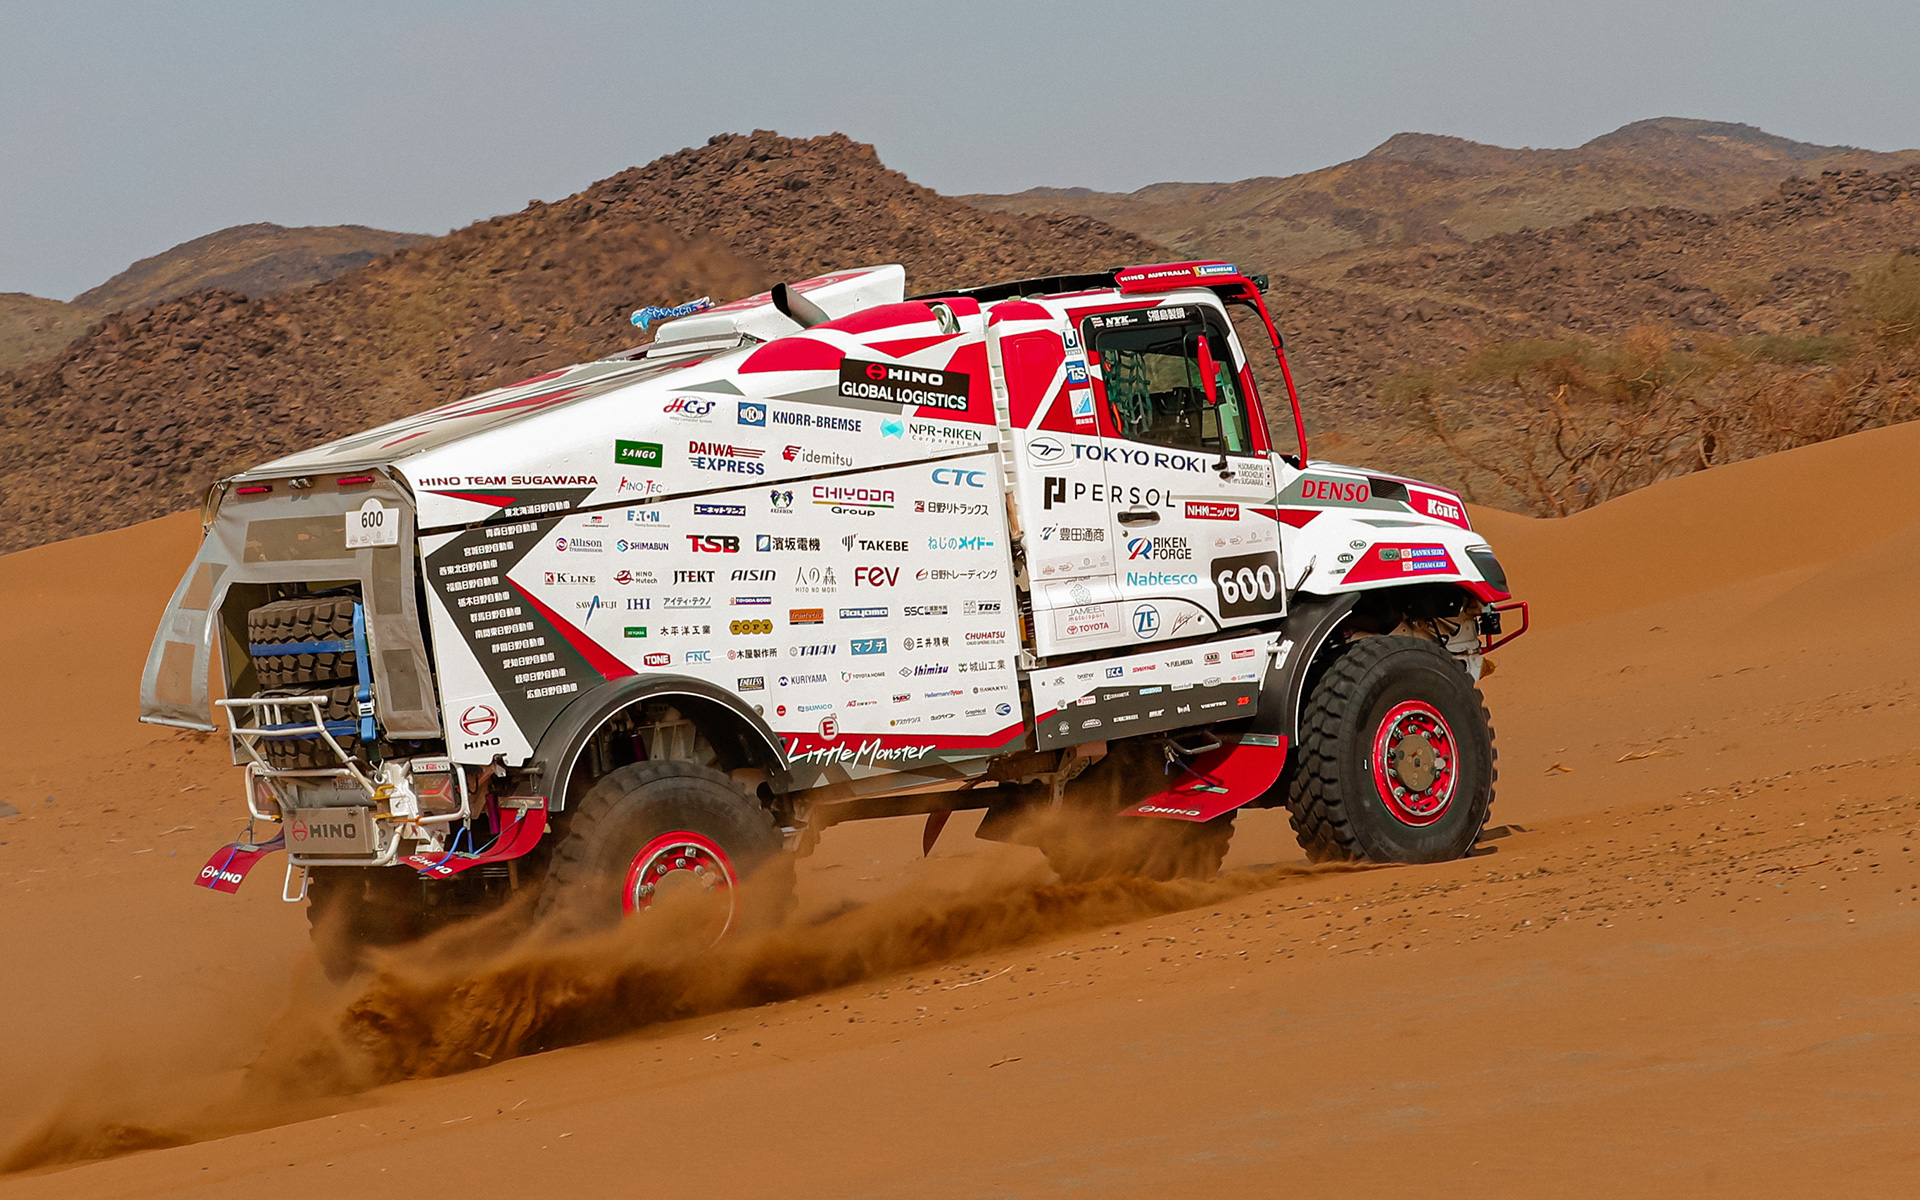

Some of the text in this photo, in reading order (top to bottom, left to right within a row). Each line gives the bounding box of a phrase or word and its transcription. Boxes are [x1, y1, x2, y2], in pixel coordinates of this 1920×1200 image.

[1120, 269, 1191, 282] HINO AUSTRALIA
[888, 368, 944, 386] HINO
[841, 381, 967, 410] GLOBAL LOGISTICS
[663, 398, 716, 414] HCS
[772, 410, 862, 432] KNORR-BREMSE
[909, 423, 982, 441] NPR-RIKEN
[622, 448, 656, 460] SANGO
[689, 441, 735, 457] DAIWA
[802, 449, 853, 467] idemitsu
[1071, 444, 1206, 473] TOKYO ROKI
[697, 457, 765, 475] EXPRESS
[419, 475, 599, 487] HINO TEAM SUGAWARA
[932, 468, 987, 488] CTC
[812, 486, 894, 502] CHIYODA
[1074, 483, 1176, 507] PERSOL
[1302, 479, 1370, 503] DENSO
[831, 506, 876, 517] Group
[928, 501, 989, 516] 日野リトラックス
[1187, 505, 1237, 518] NHKニッパツ
[362, 510, 384, 528] 600
[1059, 528, 1104, 542] 豊田通商
[568, 538, 602, 548] Allison
[630, 542, 669, 550] SHIMABUN
[686, 534, 740, 554] TSB
[858, 540, 909, 552] TAKEBE
[928, 536, 994, 551] ねじのメイドー
[1153, 537, 1187, 548] RIKEN
[1153, 548, 1192, 560] FORGE
[571, 575, 596, 583] LINE
[673, 570, 715, 585] JTEKT
[731, 570, 777, 581] AISIN
[795, 566, 837, 586] 人の森
[1127, 571, 1198, 586] Nabtesco
[1218, 564, 1276, 604] 600
[626, 598, 651, 610] IHI
[978, 603, 1001, 611] TDS
[904, 607, 924, 616] SSC
[1068, 606, 1105, 616] JAMEEL
[660, 626, 711, 636] 太平洋工業
[1080, 622, 1110, 632] TOYOTA
[964, 630, 1006, 640] CHUHATSU
[798, 644, 836, 656] TAIAN
[852, 640, 886, 652] マブチ
[645, 654, 670, 665] TONE
[686, 650, 711, 662] FNC
[914, 662, 949, 677] Shimizu
[790, 674, 828, 685] KURIYAMA
[804, 704, 833, 712] SUMICO
[822, 720, 835, 736] E
[464, 738, 500, 750] HINO
[787, 737, 936, 770] Little Monster
[1154, 808, 1201, 816] HINO
[310, 823, 356, 839] HINO
